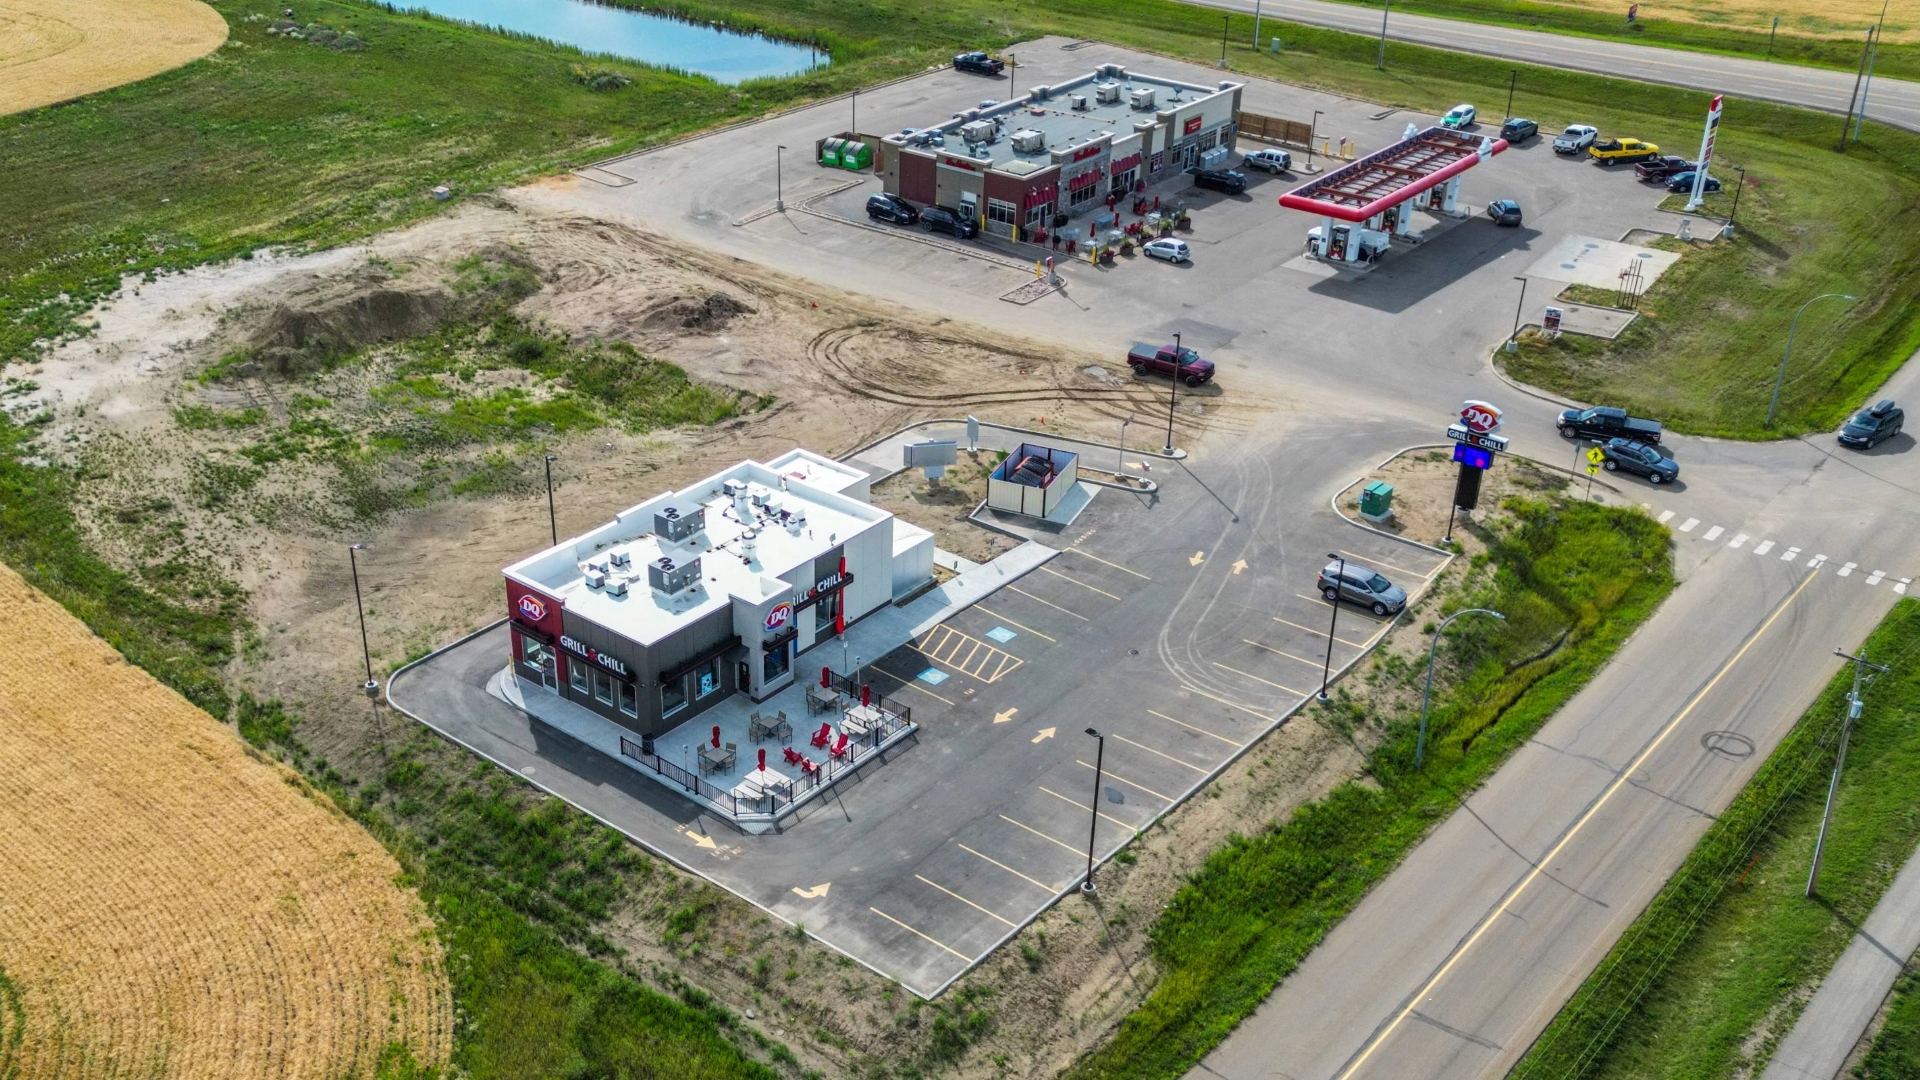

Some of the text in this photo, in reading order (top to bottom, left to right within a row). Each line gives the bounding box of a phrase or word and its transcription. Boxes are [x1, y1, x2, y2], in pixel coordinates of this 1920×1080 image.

[1465, 409, 1492, 428] DQ
[1448, 430, 1471, 441] GRILL
[1479, 438, 1502, 450] CHILL
[793, 591, 809, 605] RILL
[817, 572, 842, 592] CHILL
[524, 600, 540, 617] DQ
[770, 608, 788, 625] DQ
[560, 635, 588, 657] GRILL
[597, 653, 627, 675] CHILL
